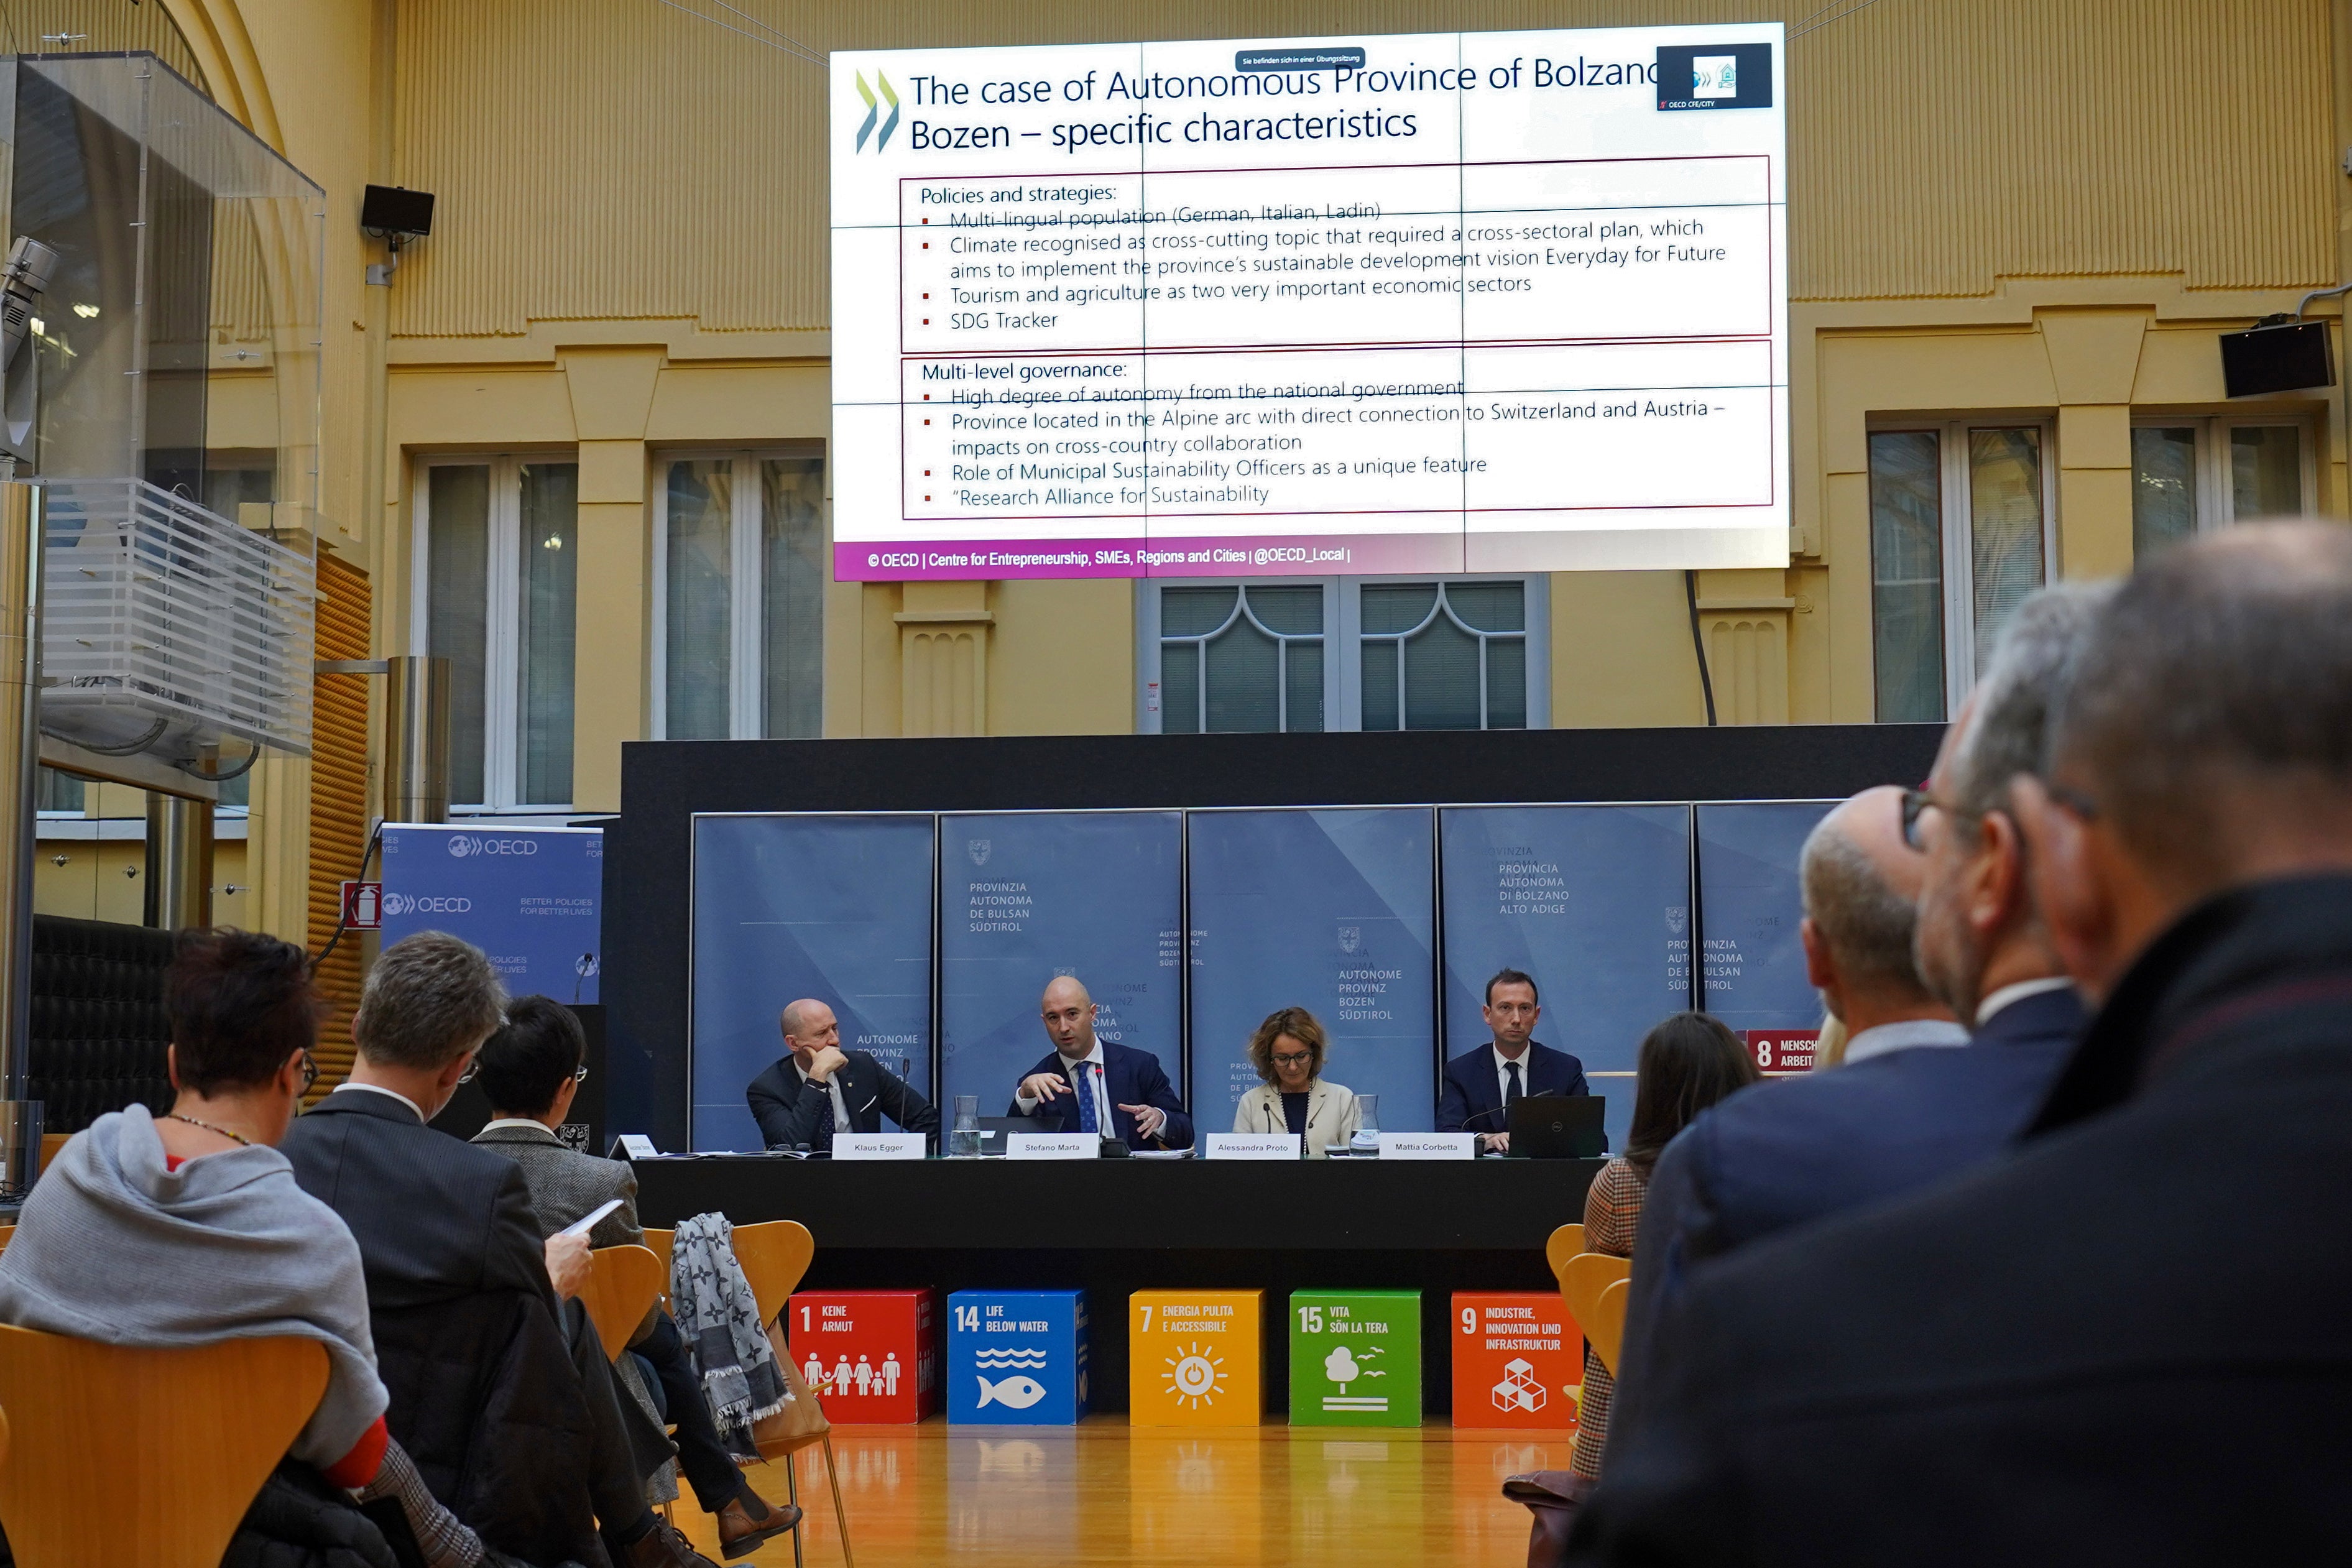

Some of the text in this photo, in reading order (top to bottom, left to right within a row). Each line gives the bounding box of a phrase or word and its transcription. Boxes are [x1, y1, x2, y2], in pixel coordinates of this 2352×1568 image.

[1316, 55, 1360, 63] Übungssitzung
[910, 75, 969, 105] The
[982, 81, 1051, 104] case
[1064, 70, 1097, 102] of
[1106, 71, 1321, 100] Autonomous
[1335, 63, 1477, 93] Province
[1488, 57, 1524, 90] of
[1688, 100, 1715, 108] CFE/CITY
[912, 108, 1416, 154] Bozen specific characteristics
[921, 184, 1117, 205] Policies and strategies:
[951, 218, 1703, 256] Climate recognised as cross-cutting topic that required a cross-sectoral plan, which
[951, 262, 990, 279] aims
[997, 263, 1015, 277] to
[1022, 260, 1117, 281] implement
[1123, 258, 1151, 274] the
[1253, 252, 1354, 272] sustainable
[1360, 252, 1481, 272] development
[1487, 249, 1539, 266] vision
[1547, 246, 1629, 269] Everyday
[1635, 246, 1661, 262] for
[1668, 245, 1725, 261] Future
[950, 276, 1531, 306] Tourism and agriculture as two very important economic sectors
[951, 311, 1058, 330] SDG Tracker
[923, 362, 1127, 384] Multi-level governance:
[953, 400, 1707, 430] Province located in the Alpine arc with direct connection to Switzerland and Austria
[952, 434, 1301, 460] impacts on cross-country collaboration
[953, 456, 1487, 484] Role of Municipal Sustainability Officers as a unique feature
[1045, 487, 1114, 505] Alliance
[1120, 487, 1144, 504] for
[1152, 485, 1269, 506] Sustainability
[882, 547, 1344, 568] OECD Centre for Entrepreneurship, SMEs, Regions and Cities @OECD_Local
[484, 840, 538, 855] OECD
[1499, 864, 1559, 874] PROVINCIA
[970, 883, 1027, 892] PROVINZIA
[1500, 878, 1564, 887] AUTONOMA
[970, 896, 1032, 905] AUTONOMA
[1500, 891, 1569, 901] DI BOLZANO
[417, 897, 471, 913] OECD
[520, 898, 593, 906] BETTER POLICIES
[539, 907, 569, 915] BETTER
[570, 908, 593, 916] LIVES
[970, 909, 1030, 919] DE BULSAN
[1500, 905, 1566, 914] ALTO ADIGE
[970, 921, 1022, 932] SÜDTIROL
[1339, 970, 1403, 979] AUTONOME
[1339, 984, 1386, 993] PROVINZ
[1339, 997, 1375, 1007] BOZEN
[1339, 1009, 1393, 1020] SÜDTIROL
[857, 1035, 918, 1044] AUTONOME
[1757, 1040, 1772, 1067] 8
[854, 1143, 903, 1153] Klaus Egger
[822, 1306, 847, 1317] KEINE
[986, 1306, 1003, 1317] LIFE
[1163, 1306, 1234, 1317] ENERGIA PULITA
[1330, 1306, 1350, 1317] VITA
[1486, 1307, 1536, 1320] INDUSTRIE,
[801, 1306, 810, 1332] 1
[954, 1306, 980, 1332] 14
[1140, 1306, 1153, 1332] 7
[1298, 1306, 1322, 1333] 15
[1462, 1307, 1477, 1334] 9
[822, 1321, 853, 1332] ARMUT
[986, 1321, 1048, 1332] BELOW WATER
[1163, 1321, 1227, 1332] E ACCESSIBILE
[1330, 1319, 1388, 1334] SÖN LA TERA
[1486, 1323, 1561, 1334] INNOVATION UND
[1486, 1339, 1561, 1350] INFRASTRUKTUR
